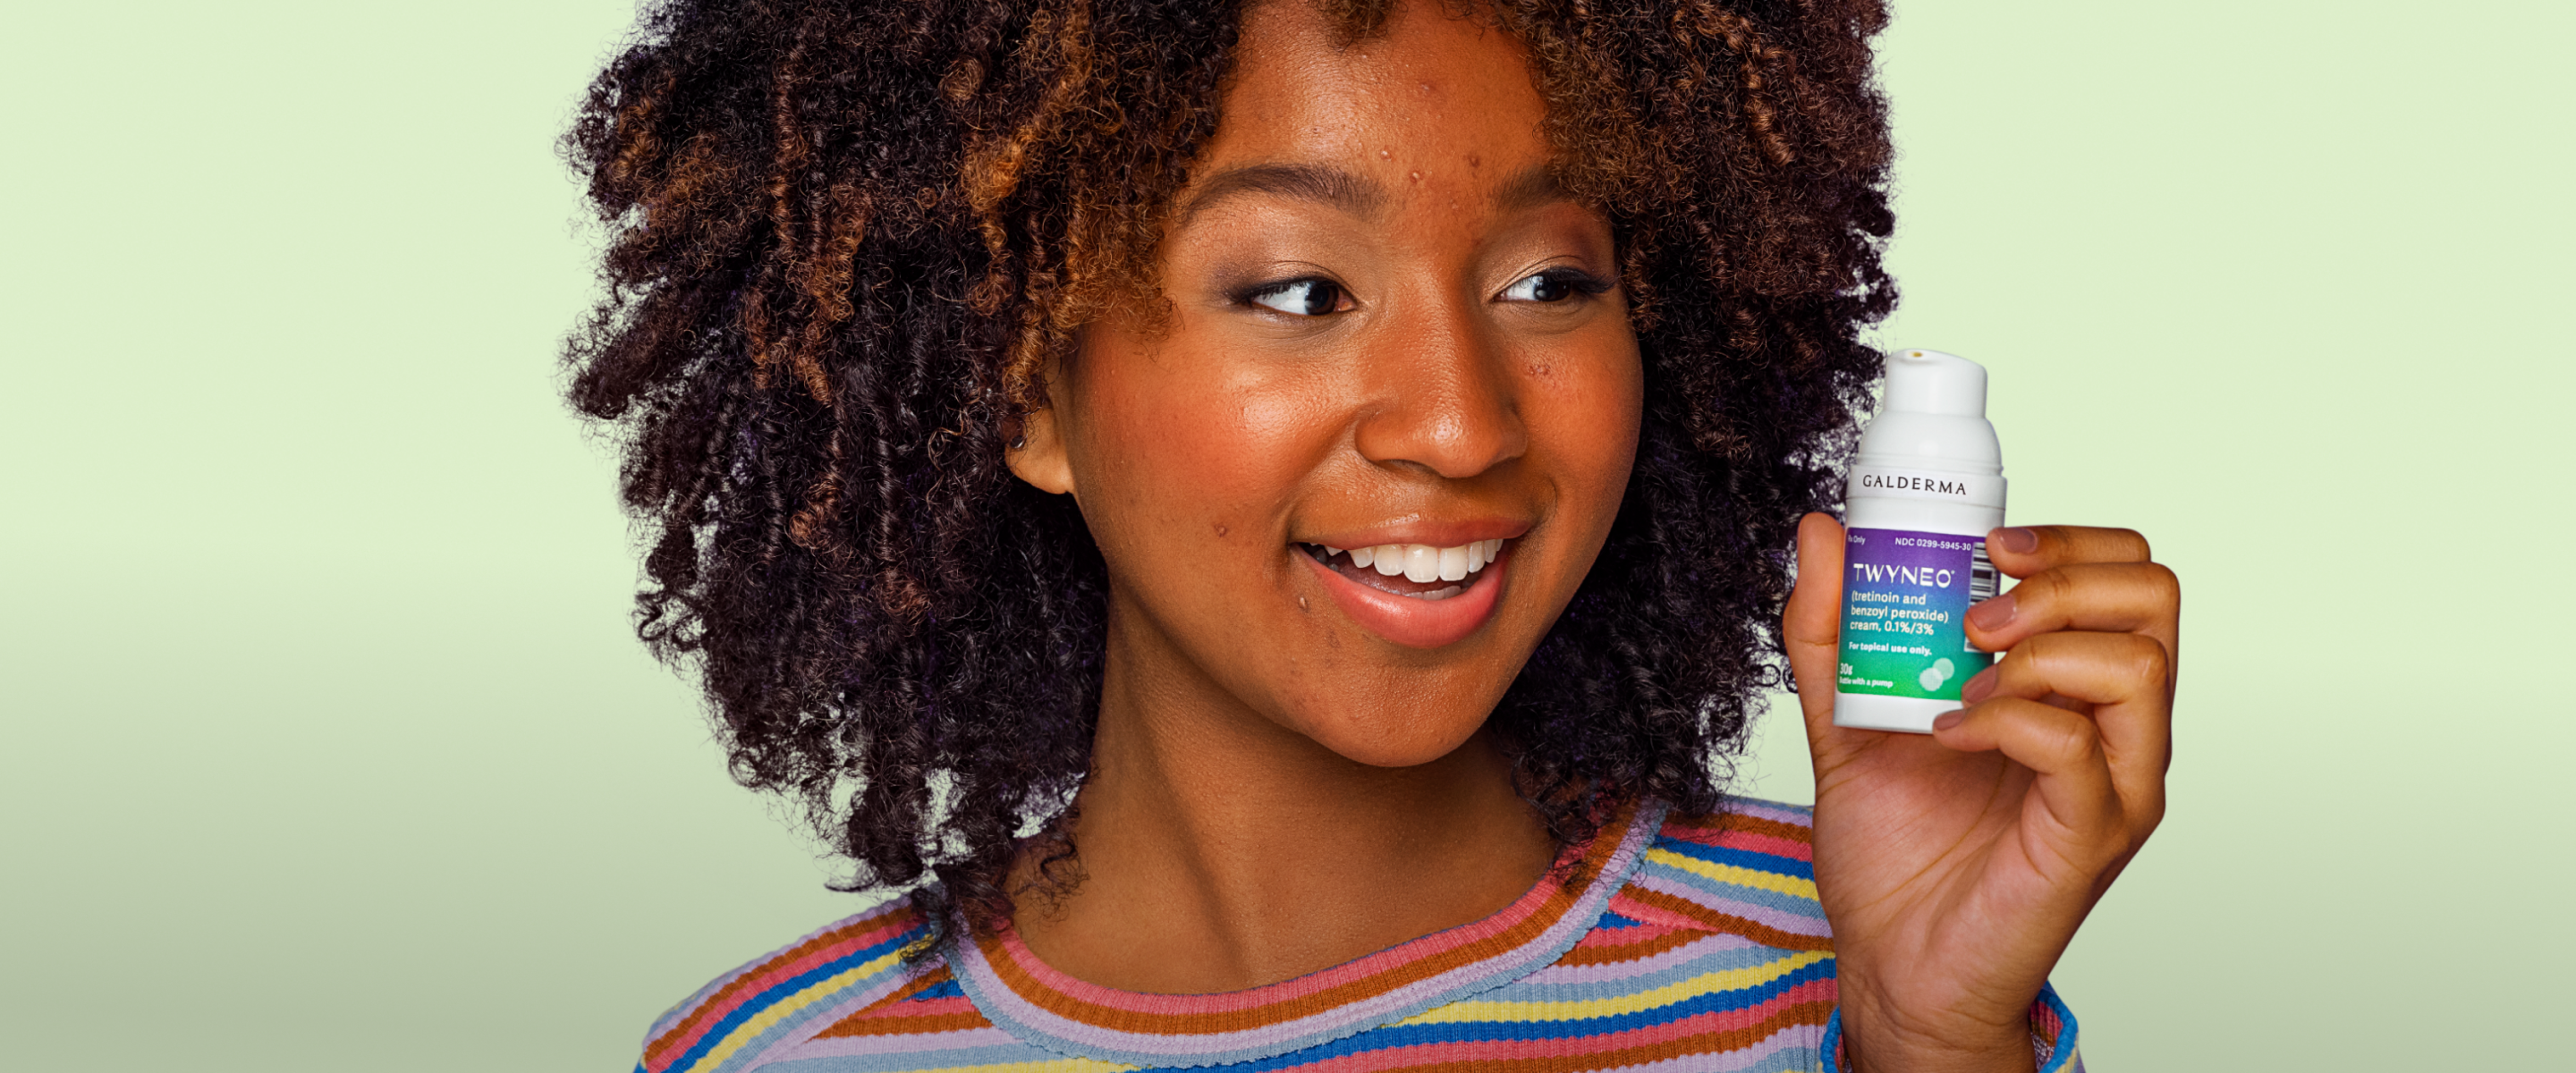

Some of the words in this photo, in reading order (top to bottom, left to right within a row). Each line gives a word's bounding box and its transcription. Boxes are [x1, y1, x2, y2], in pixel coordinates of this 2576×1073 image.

[1862, 475, 1966, 495] GALDERMA
[1853, 535, 1866, 545] Only
[1895, 537, 1915, 546] NDC
[1917, 538, 1971, 551] 0299-5945-30
[1852, 590, 1900, 603] (tretinoin
[1902, 594, 1926, 605] and
[1851, 604, 1888, 620] benzoyl
[1891, 609, 1949, 623] peroxide)
[1850, 621, 1882, 633] cream,
[1884, 621, 1935, 636] 0.1%/3%
[1849, 641, 1859, 650] For
[1860, 642, 1889, 653] topical
[1891, 645, 1908, 654] use
[1909, 646, 1932, 656] only.
[1840, 663, 1853, 675] 30g
[1852, 677, 1866, 685] with
[1871, 680, 1894, 689] pump
